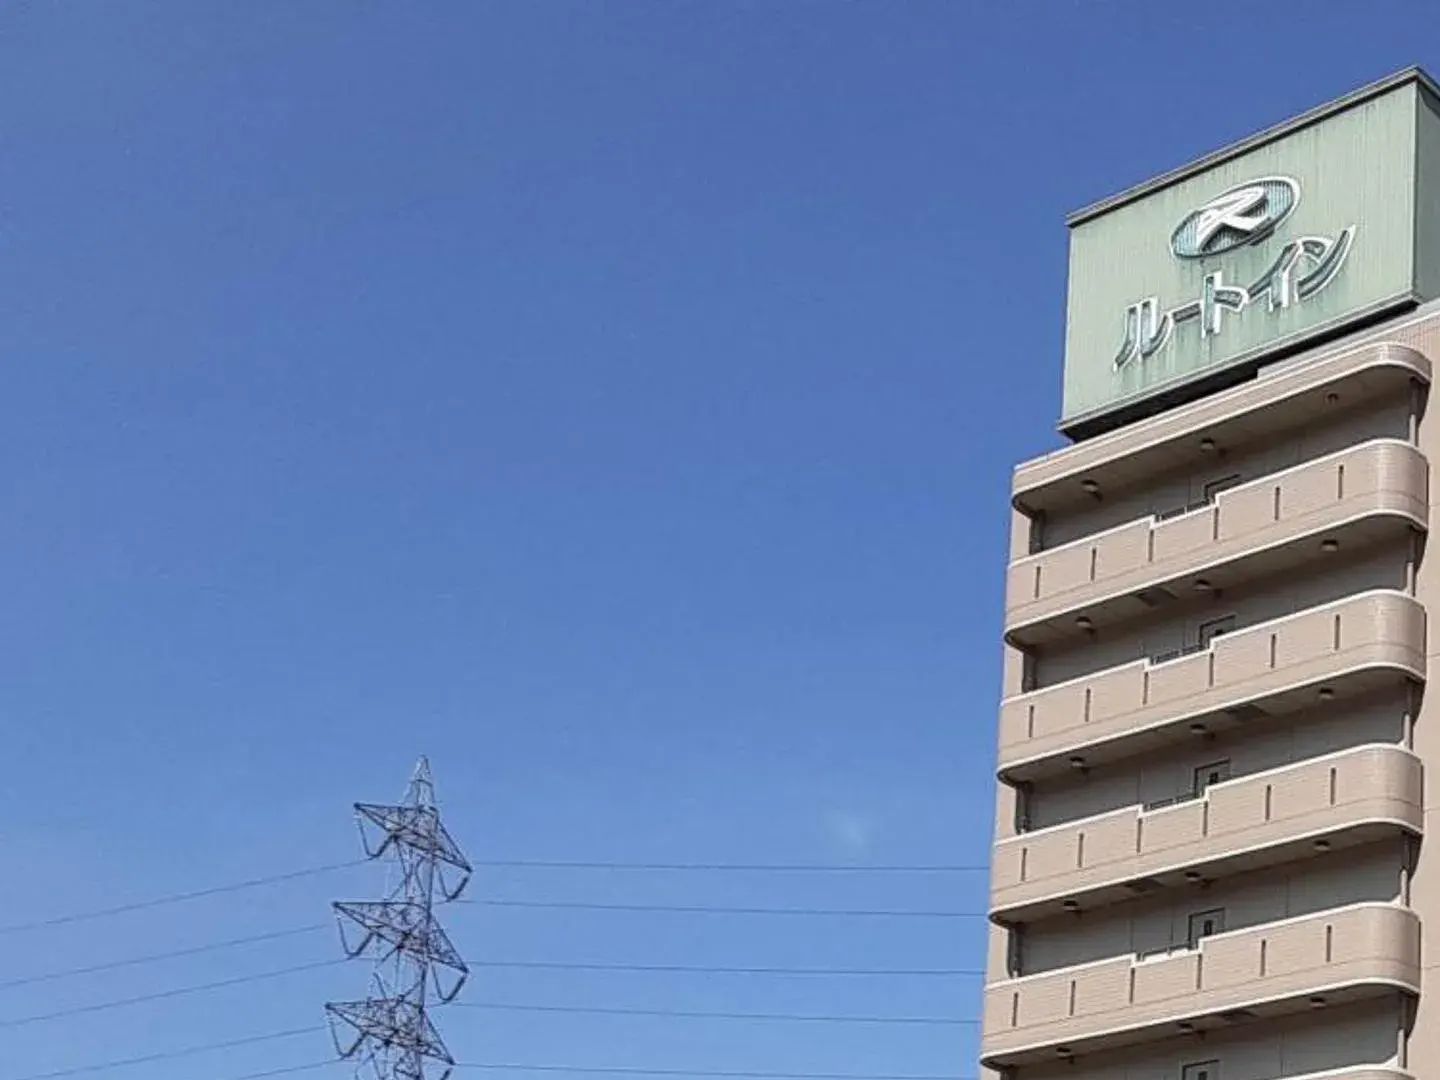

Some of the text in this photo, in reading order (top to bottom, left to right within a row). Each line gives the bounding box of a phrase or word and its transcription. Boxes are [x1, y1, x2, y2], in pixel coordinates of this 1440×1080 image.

[1113, 224, 1357, 373] ルートイン
